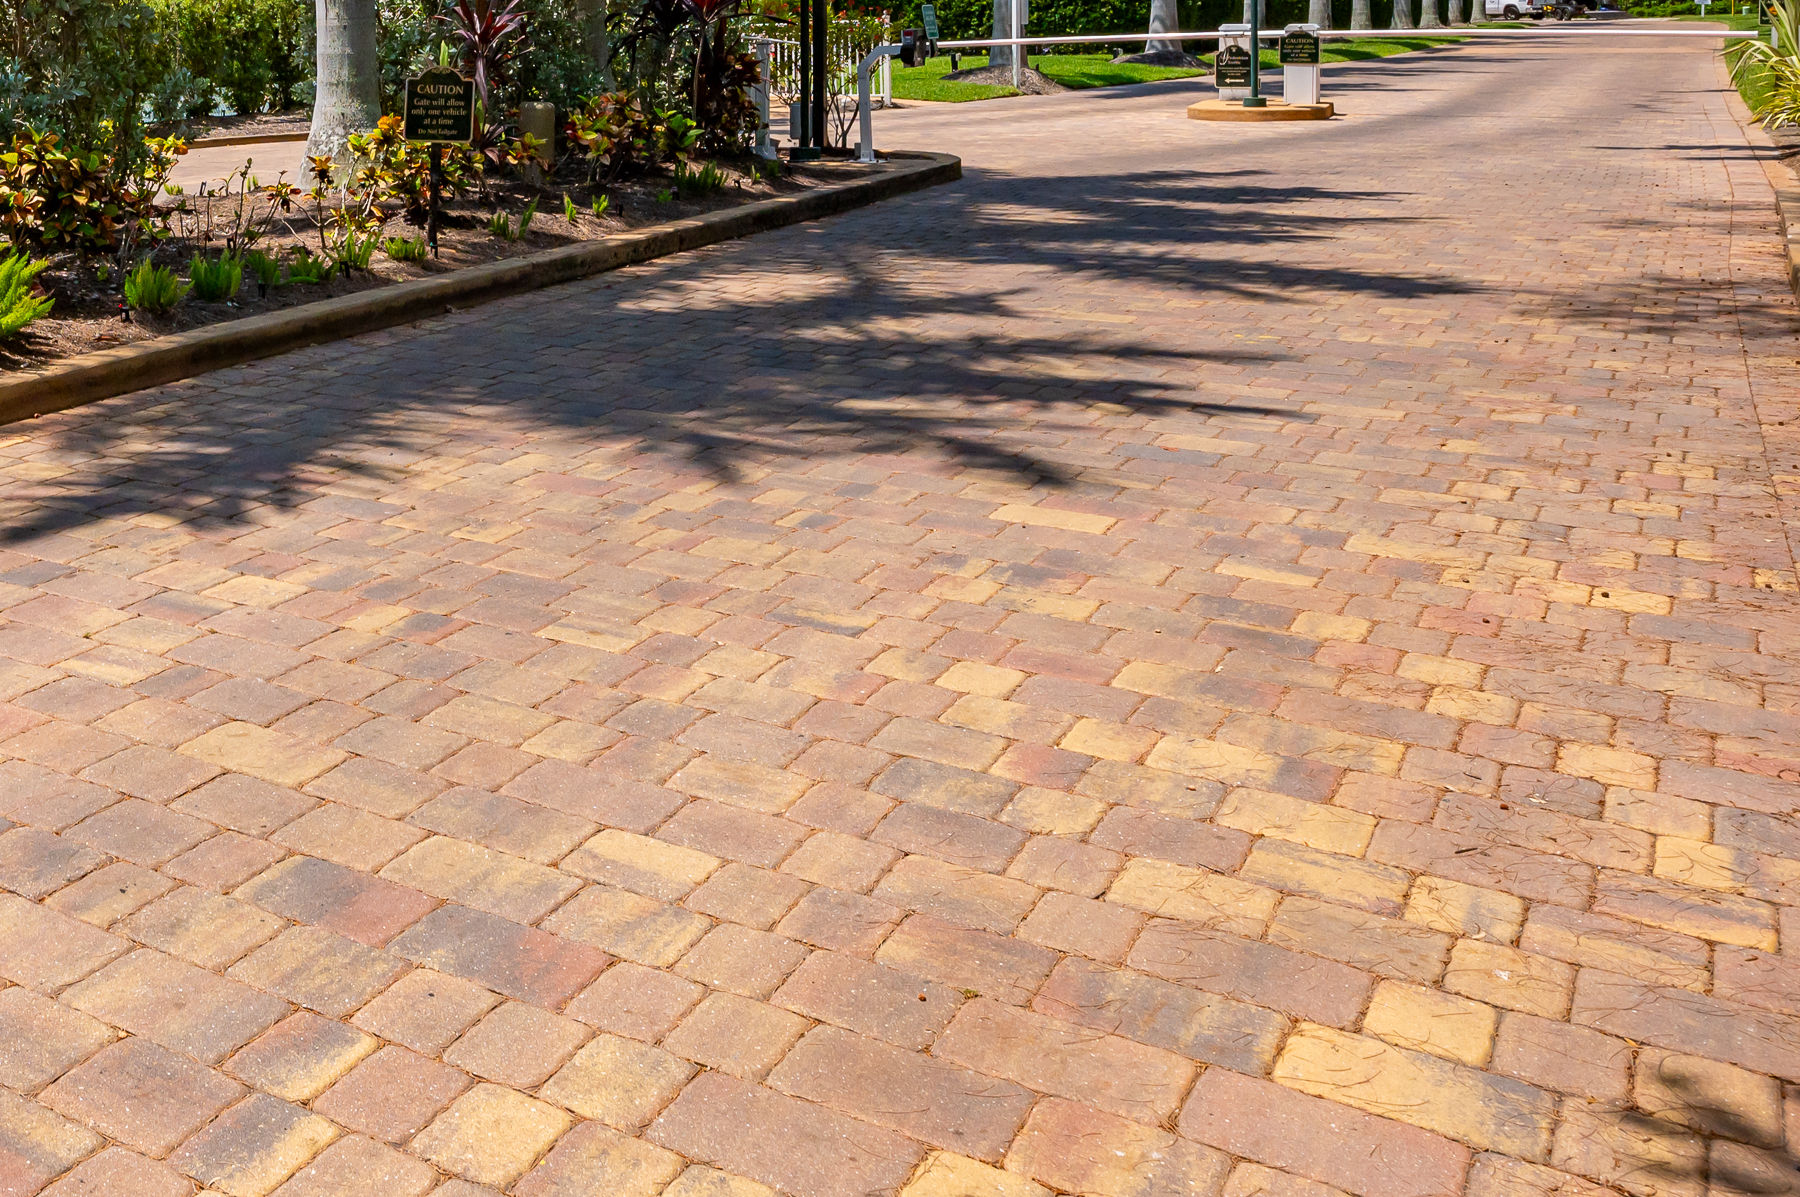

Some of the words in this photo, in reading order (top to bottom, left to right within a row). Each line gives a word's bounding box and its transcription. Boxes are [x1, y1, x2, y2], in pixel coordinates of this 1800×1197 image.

[417, 84, 464, 94] CAUTION
[447, 98, 465, 106] allow
[411, 107, 426, 116] only
[443, 107, 467, 116] vehicle
[439, 117, 454, 125] time
